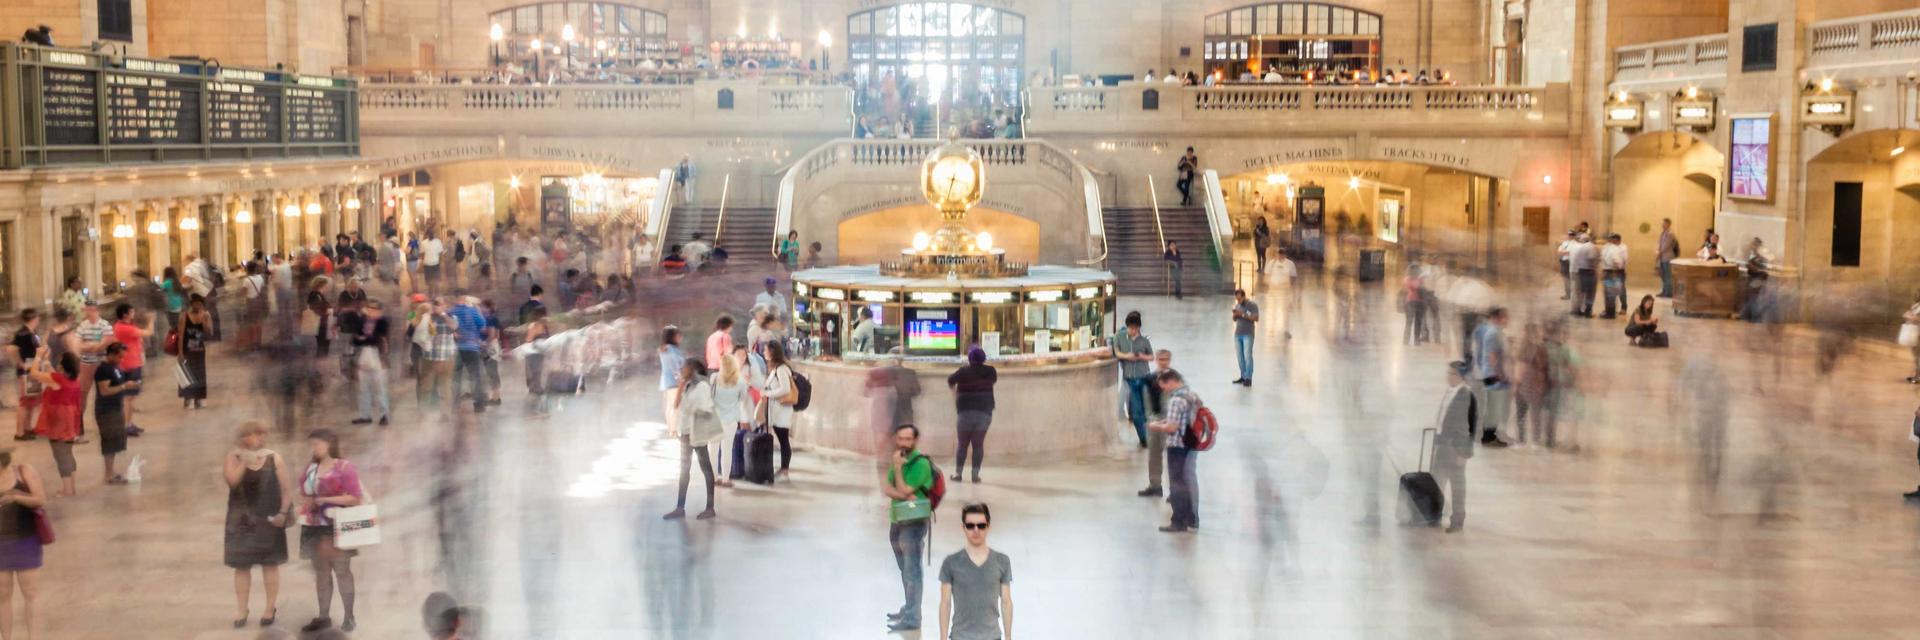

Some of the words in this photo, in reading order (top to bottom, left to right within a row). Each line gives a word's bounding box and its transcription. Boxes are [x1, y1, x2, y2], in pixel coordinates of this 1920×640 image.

[383, 151, 428, 168] TICKET
[430, 145, 493, 161] MACHINES
[532, 145, 577, 159] SUBWAY
[1244, 154, 1281, 169] TICKET
[1285, 147, 1343, 161] MACHINES
[1384, 146, 1425, 159] TRACKS
[1442, 152, 1456, 164] TO
[1306, 164, 1349, 176] WAITING
[936, 254, 986, 266] Information
